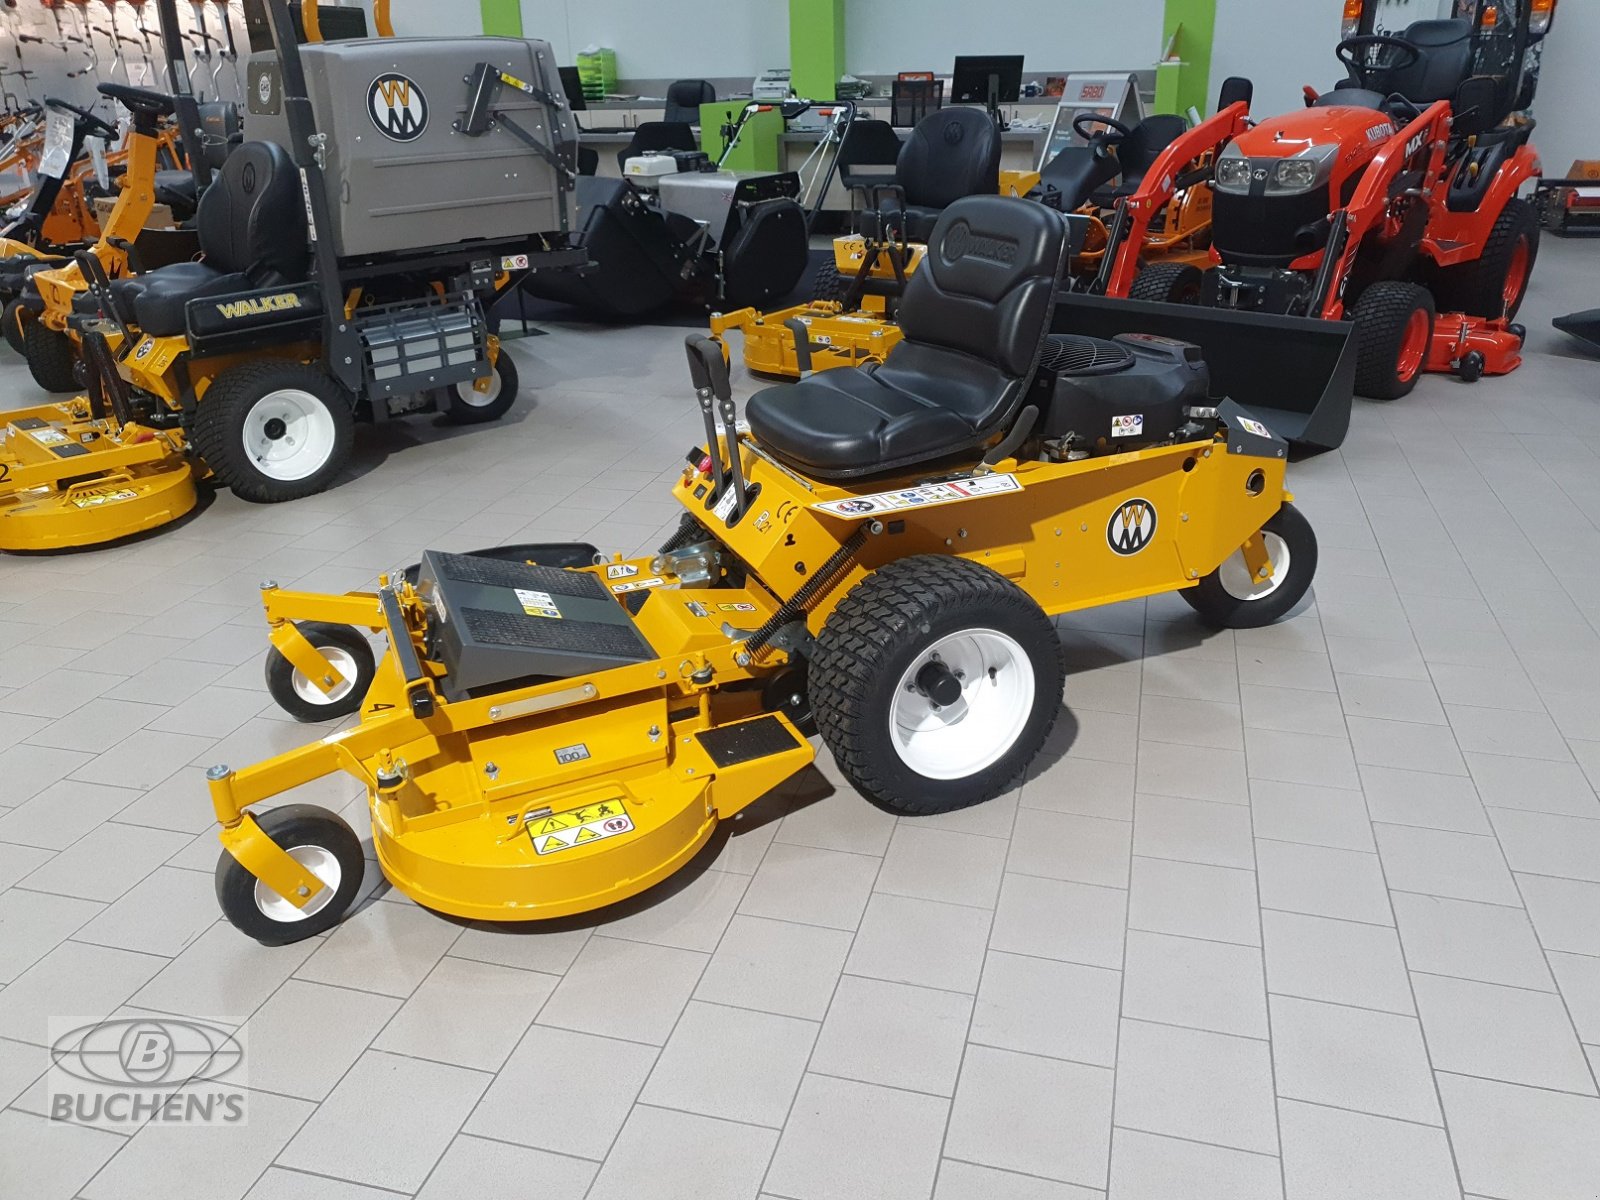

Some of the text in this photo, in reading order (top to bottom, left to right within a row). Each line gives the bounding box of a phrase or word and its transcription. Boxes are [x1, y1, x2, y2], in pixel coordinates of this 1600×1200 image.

[1366, 122, 1394, 141] KUBOTA
[968, 236, 1018, 264] WALKER
[216, 292, 302, 319] WALKER
[560, 751, 580, 763] 100
